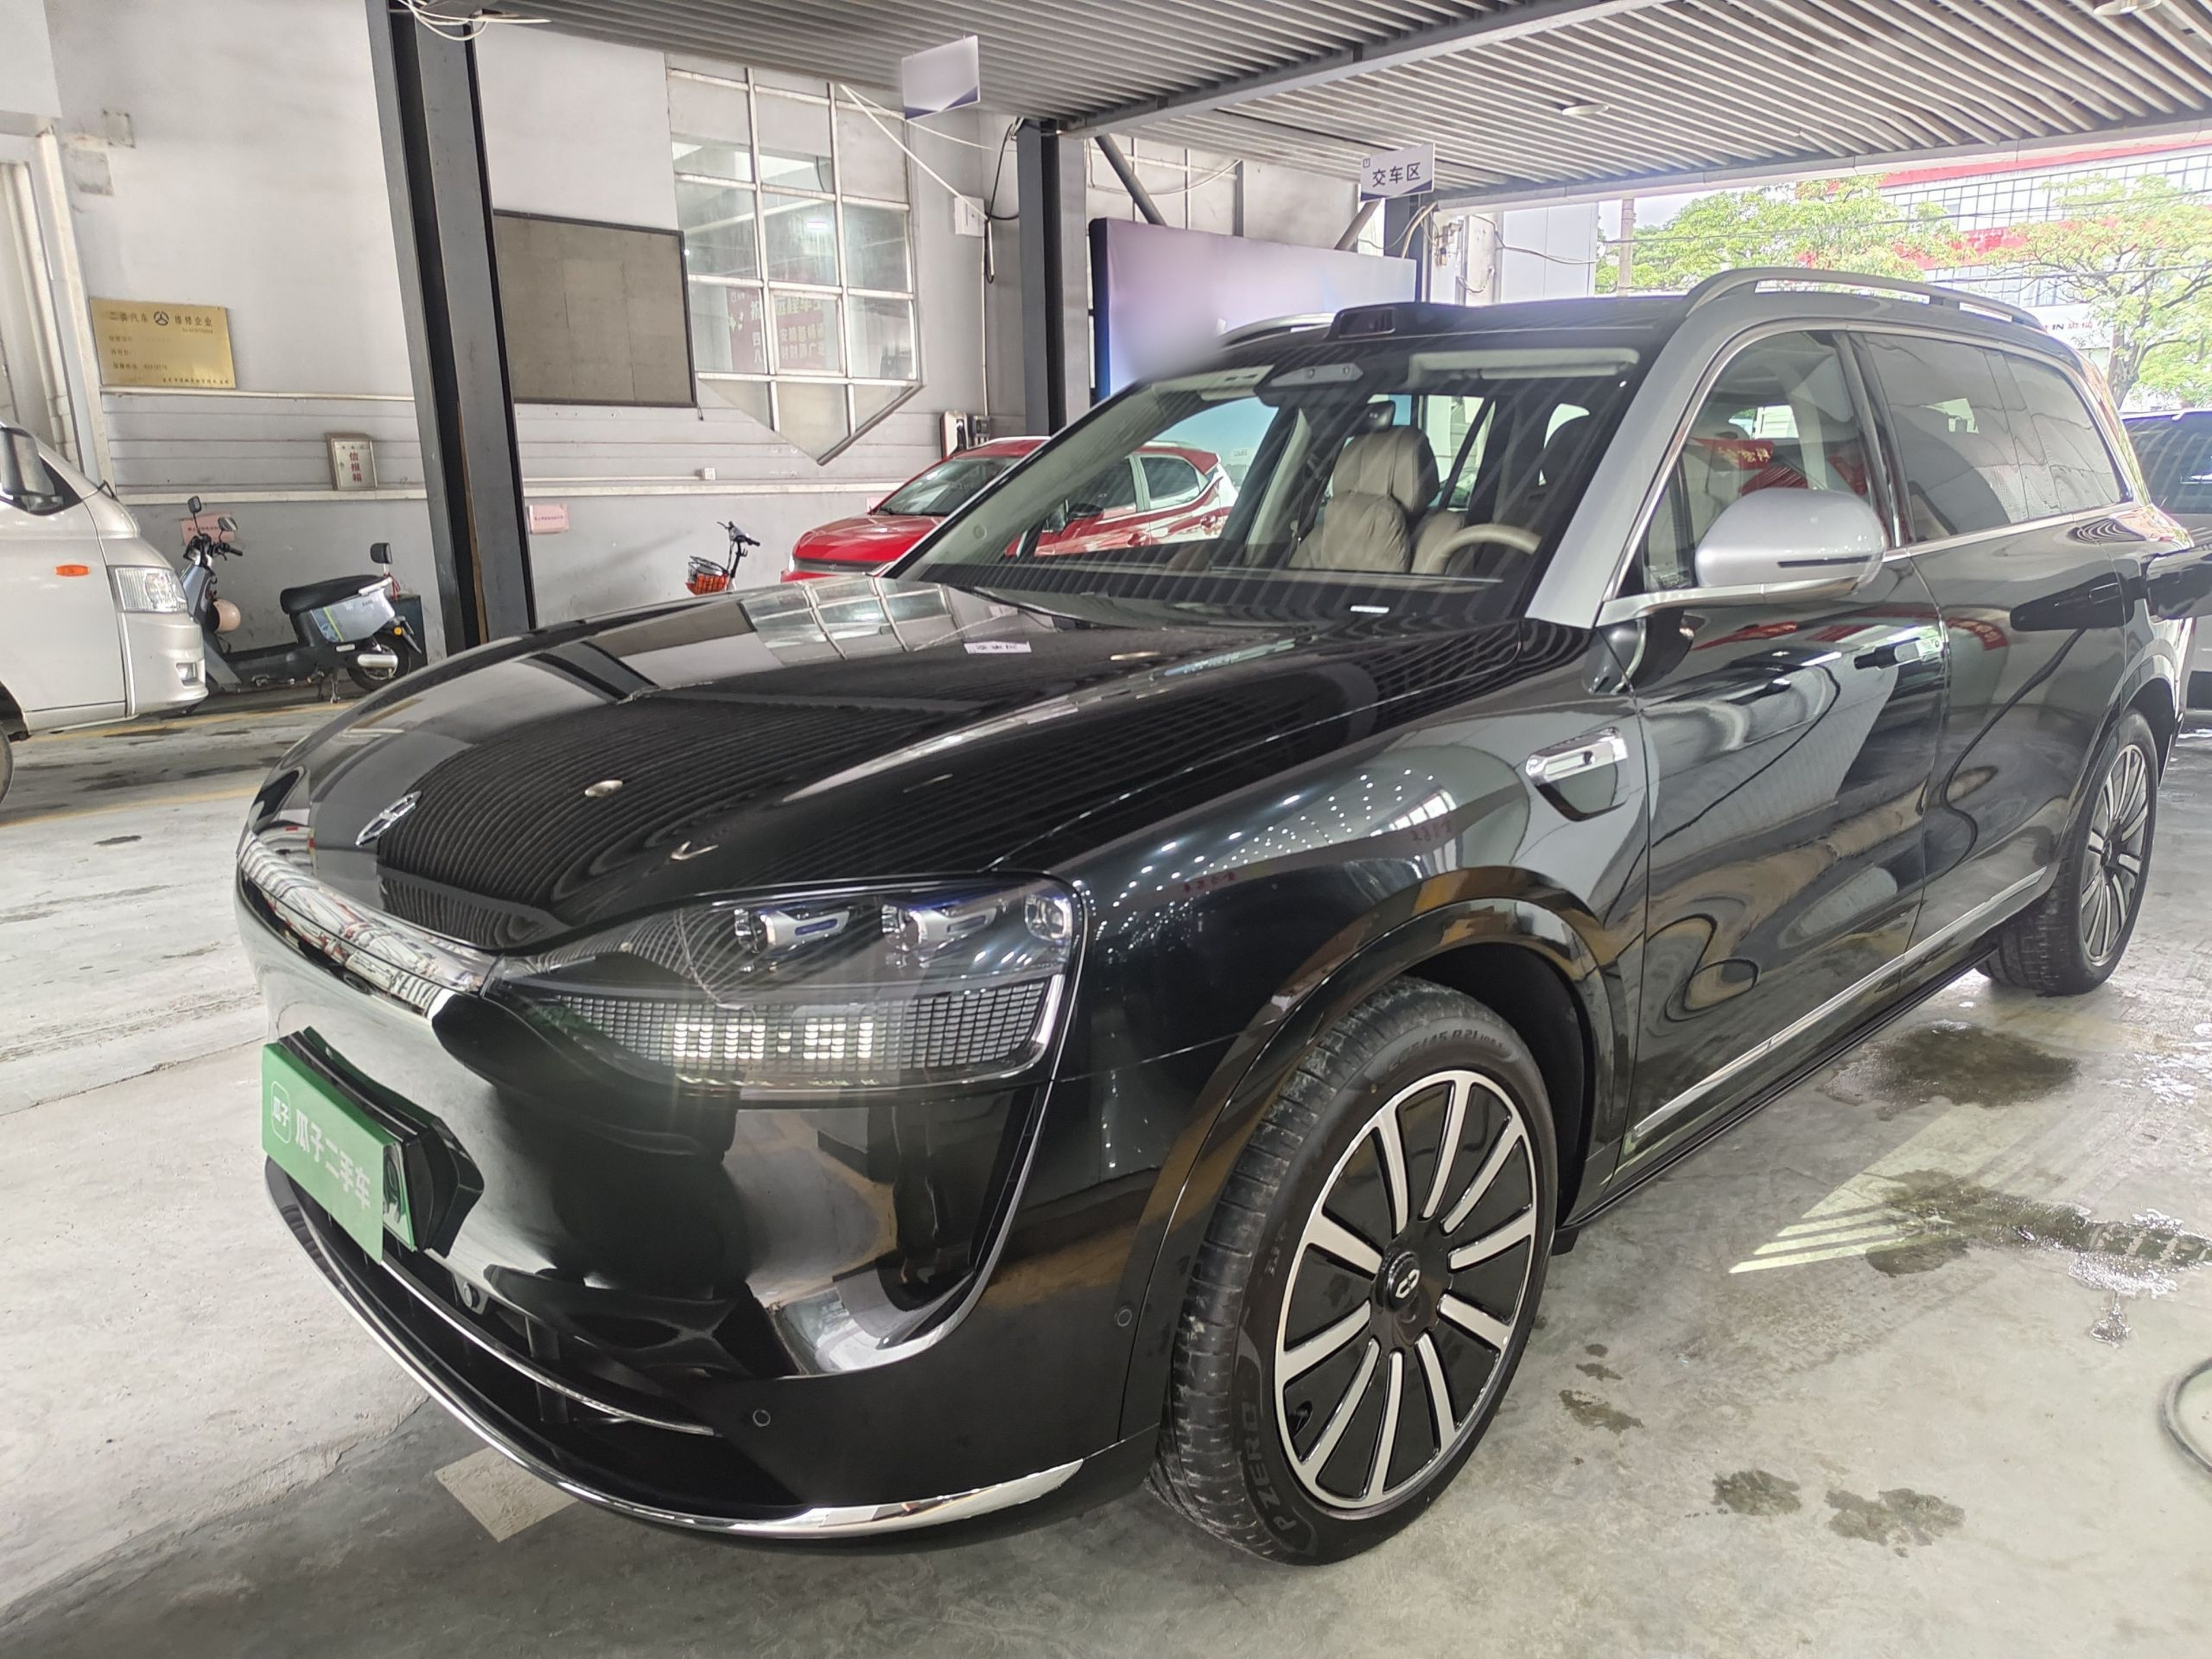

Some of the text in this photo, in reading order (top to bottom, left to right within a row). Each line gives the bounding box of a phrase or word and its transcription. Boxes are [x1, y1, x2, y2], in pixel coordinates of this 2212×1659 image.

[1373, 162, 1421, 187] 交车区
[296, 1108, 372, 1210] 瓜子二手车
